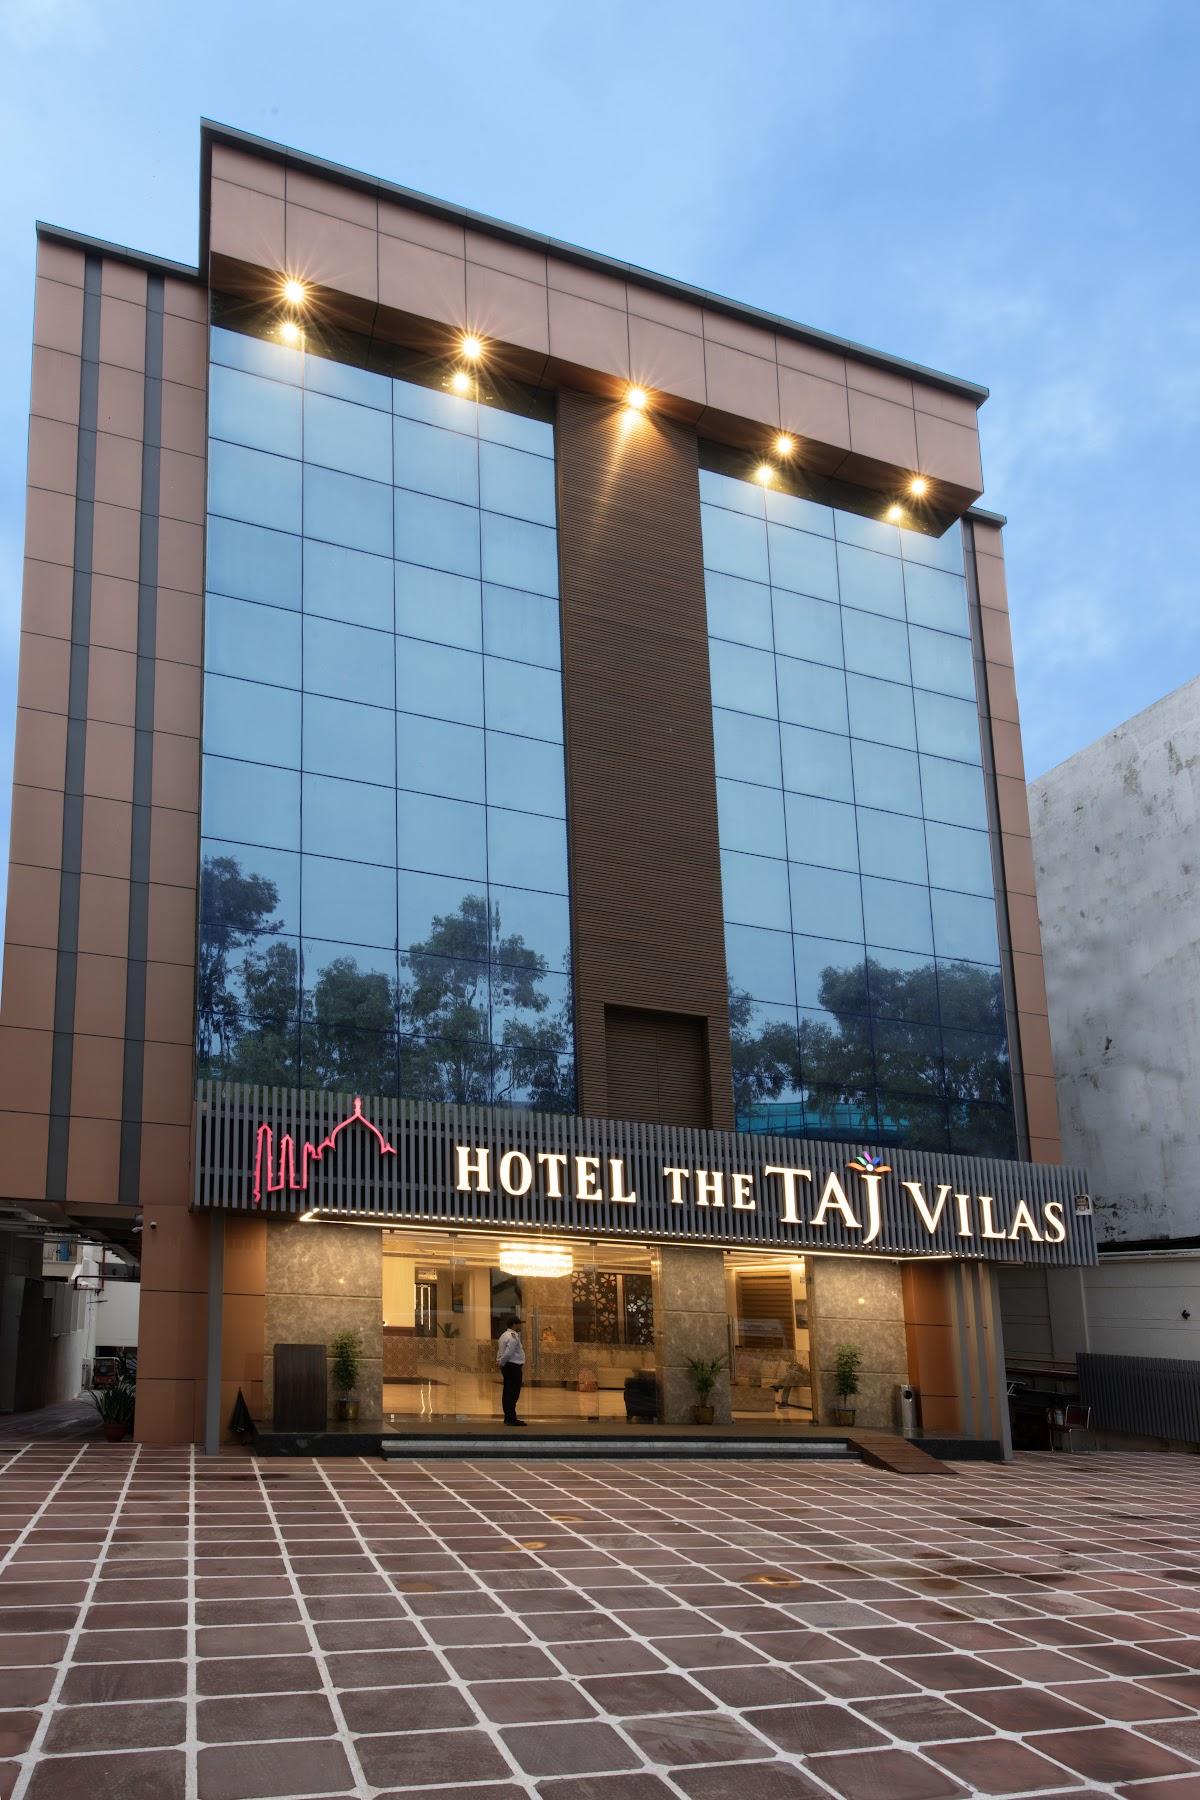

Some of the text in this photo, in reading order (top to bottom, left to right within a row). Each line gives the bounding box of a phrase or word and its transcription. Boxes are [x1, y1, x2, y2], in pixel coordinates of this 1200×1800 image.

[456, 1146, 1066, 1244] HOTEL THE TAJ VILAS
